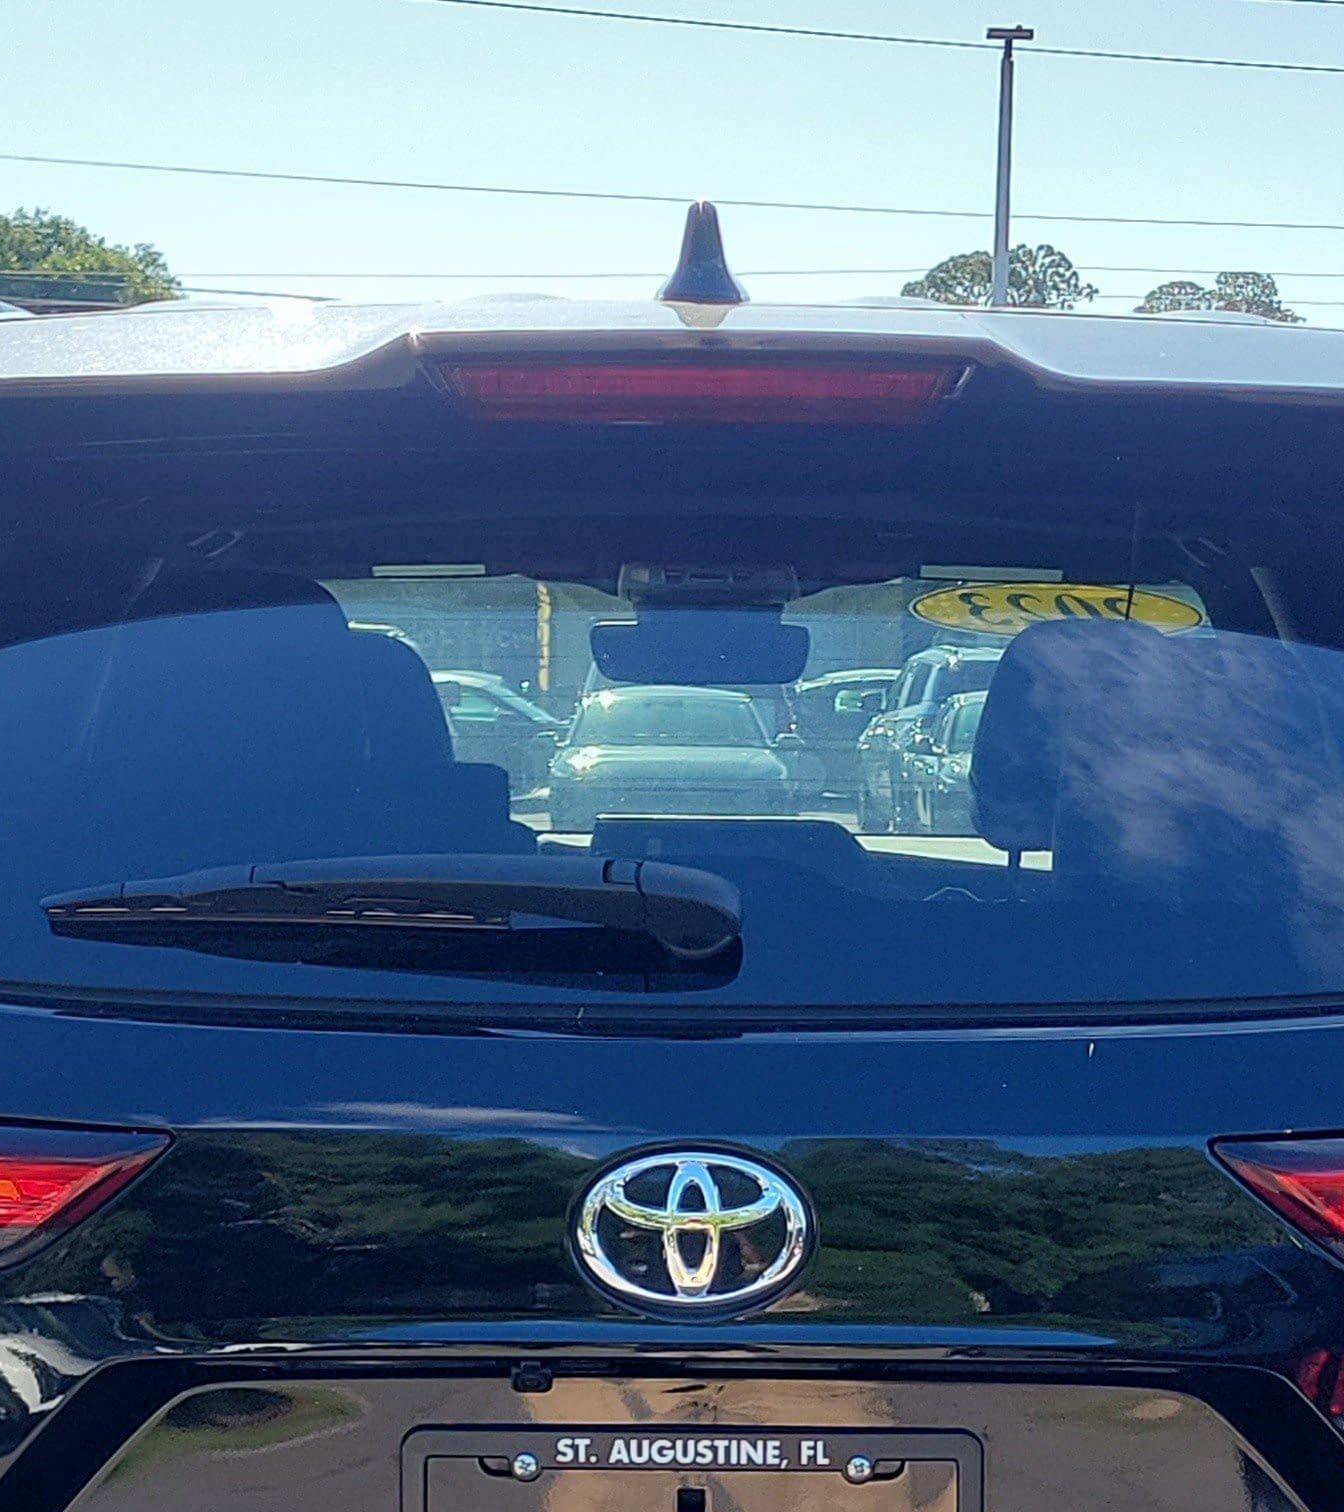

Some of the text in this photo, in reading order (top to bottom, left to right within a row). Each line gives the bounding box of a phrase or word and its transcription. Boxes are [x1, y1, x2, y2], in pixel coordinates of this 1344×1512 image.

[555, 1438, 830, 1469] ST. AUGUSTINE, FL
